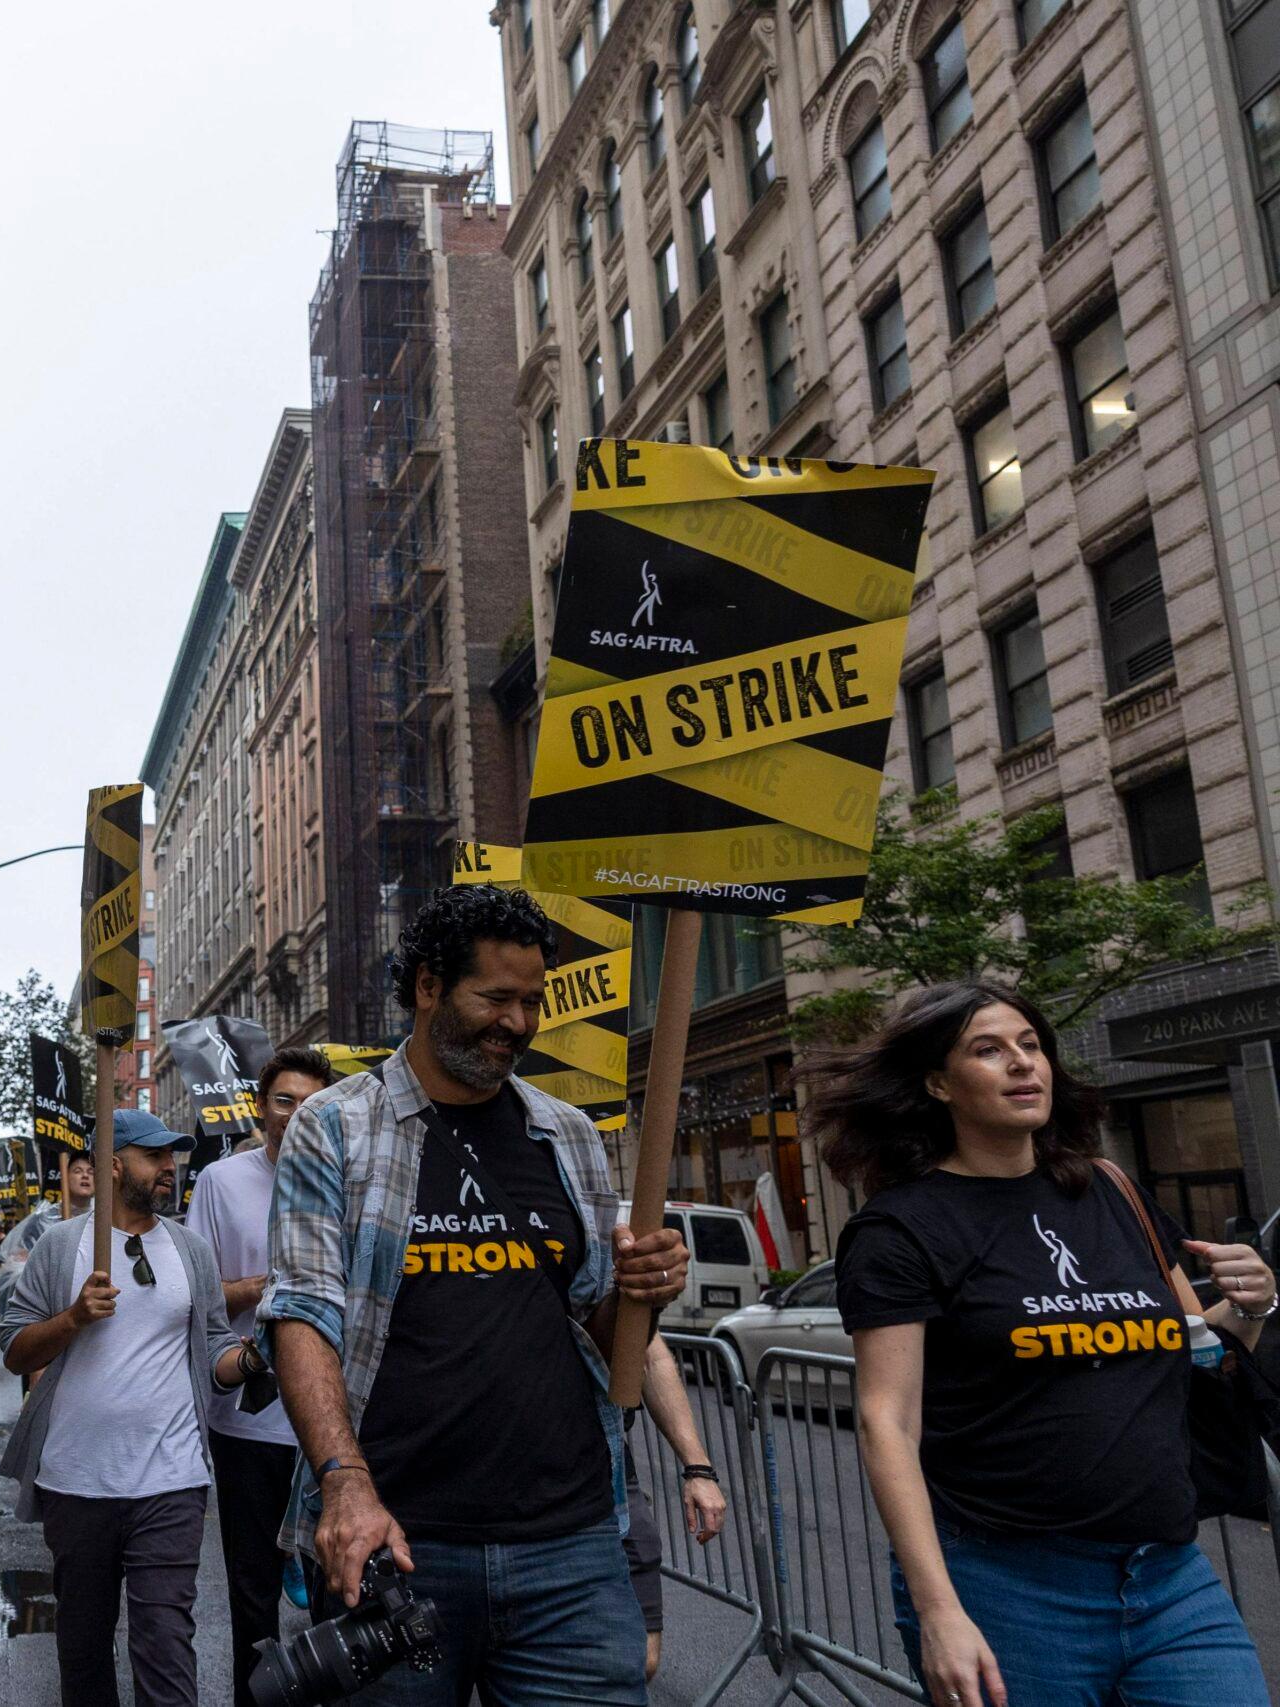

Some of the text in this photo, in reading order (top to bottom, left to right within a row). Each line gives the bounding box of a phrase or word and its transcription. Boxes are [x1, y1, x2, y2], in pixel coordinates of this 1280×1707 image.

[570, 644, 869, 768] ON STRIKE
[594, 867, 786, 903] #SAGAFTRASTRONG
[90, 887, 135, 946] STRIKE
[1180, 1008, 1225, 1036] PARK
[1232, 1000, 1269, 1025] AVE
[234, 1091, 253, 1102] ON
[35, 1117, 84, 1151] STRIKE!
[1010, 1318, 1183, 1359] STRONG
